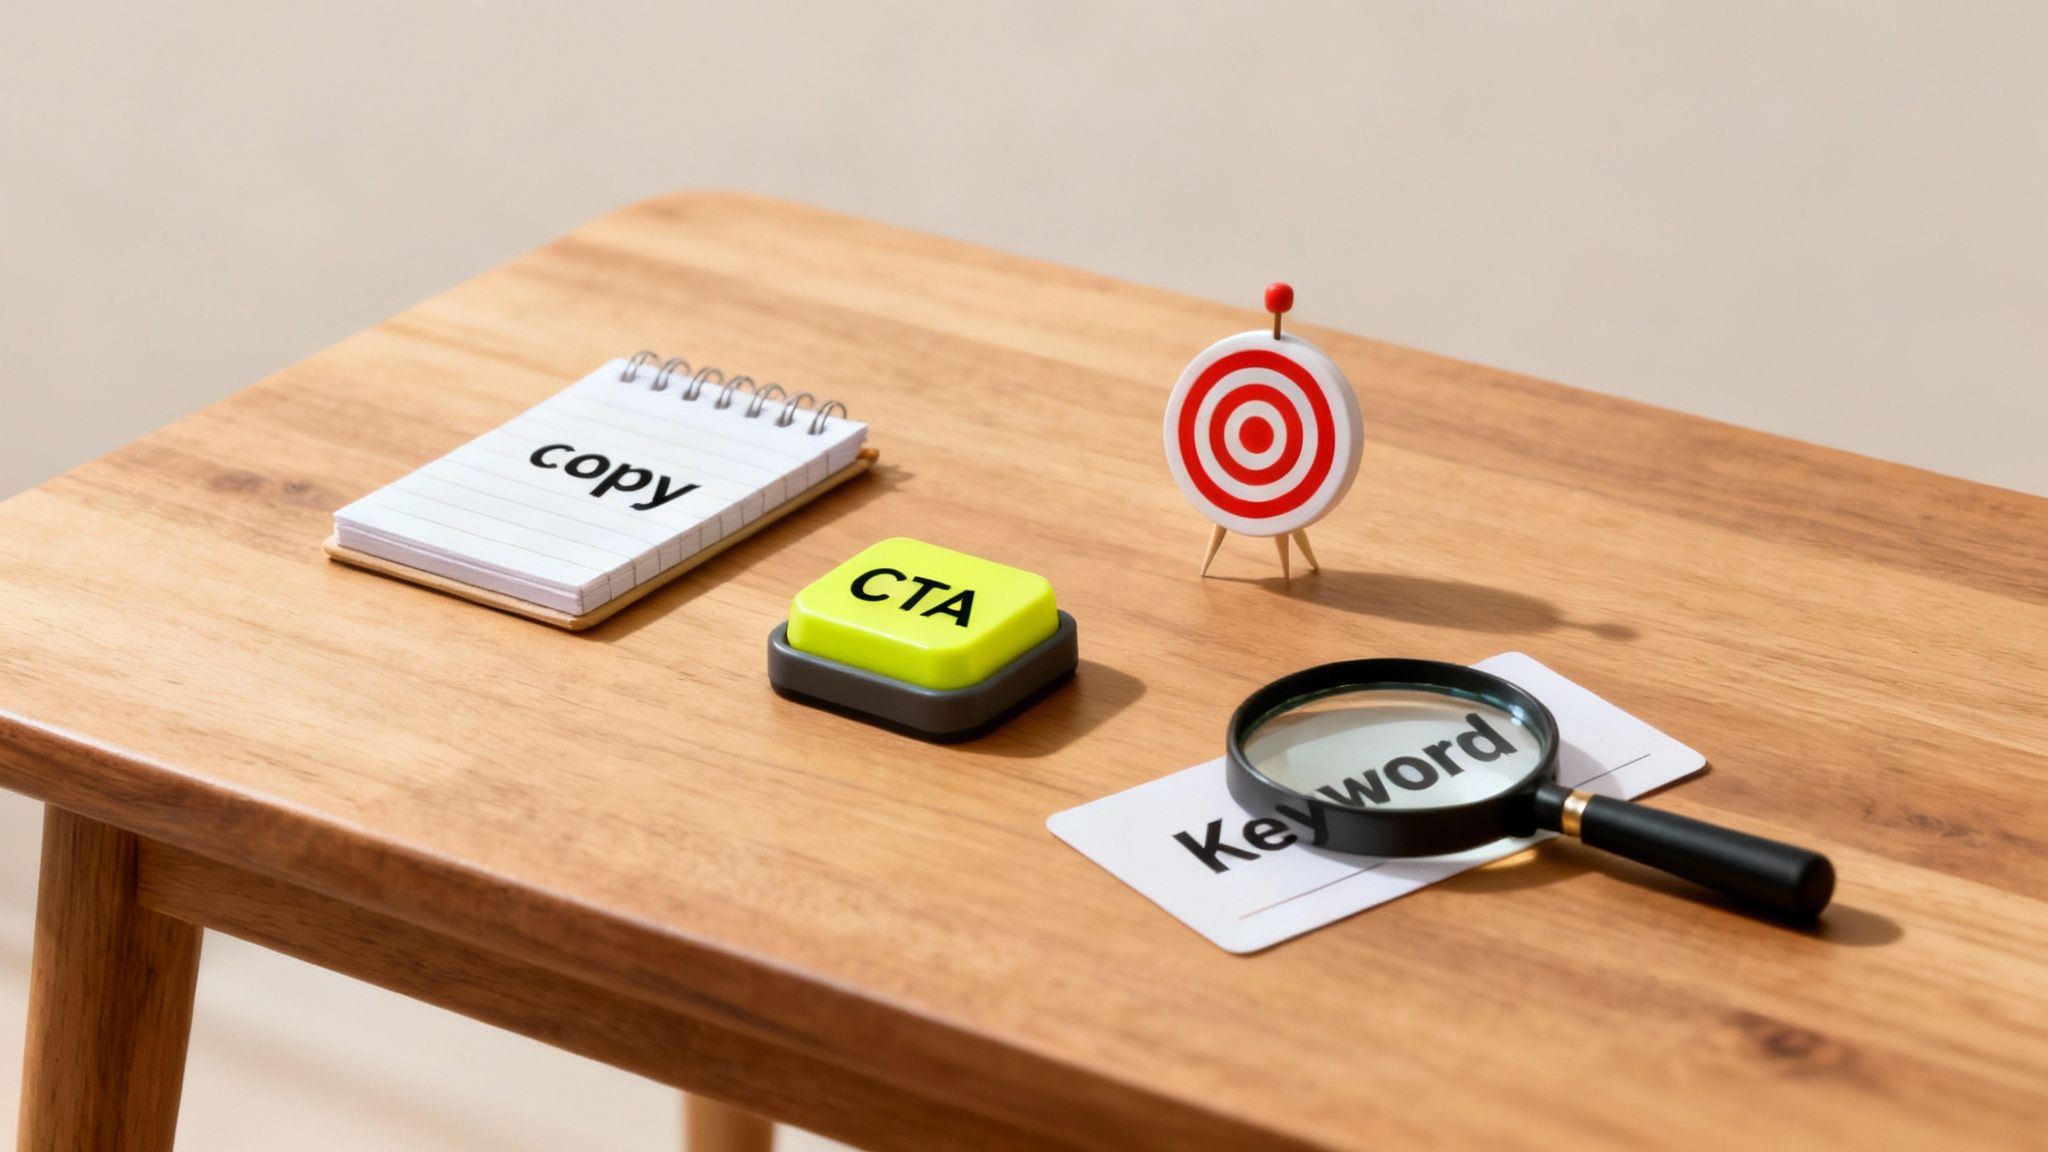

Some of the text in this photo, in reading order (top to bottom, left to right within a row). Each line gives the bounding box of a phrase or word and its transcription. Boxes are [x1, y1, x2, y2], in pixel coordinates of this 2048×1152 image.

[529, 443, 701, 511] copy
[849, 567, 976, 629] CTA
[1172, 712, 1518, 874] Keyword
